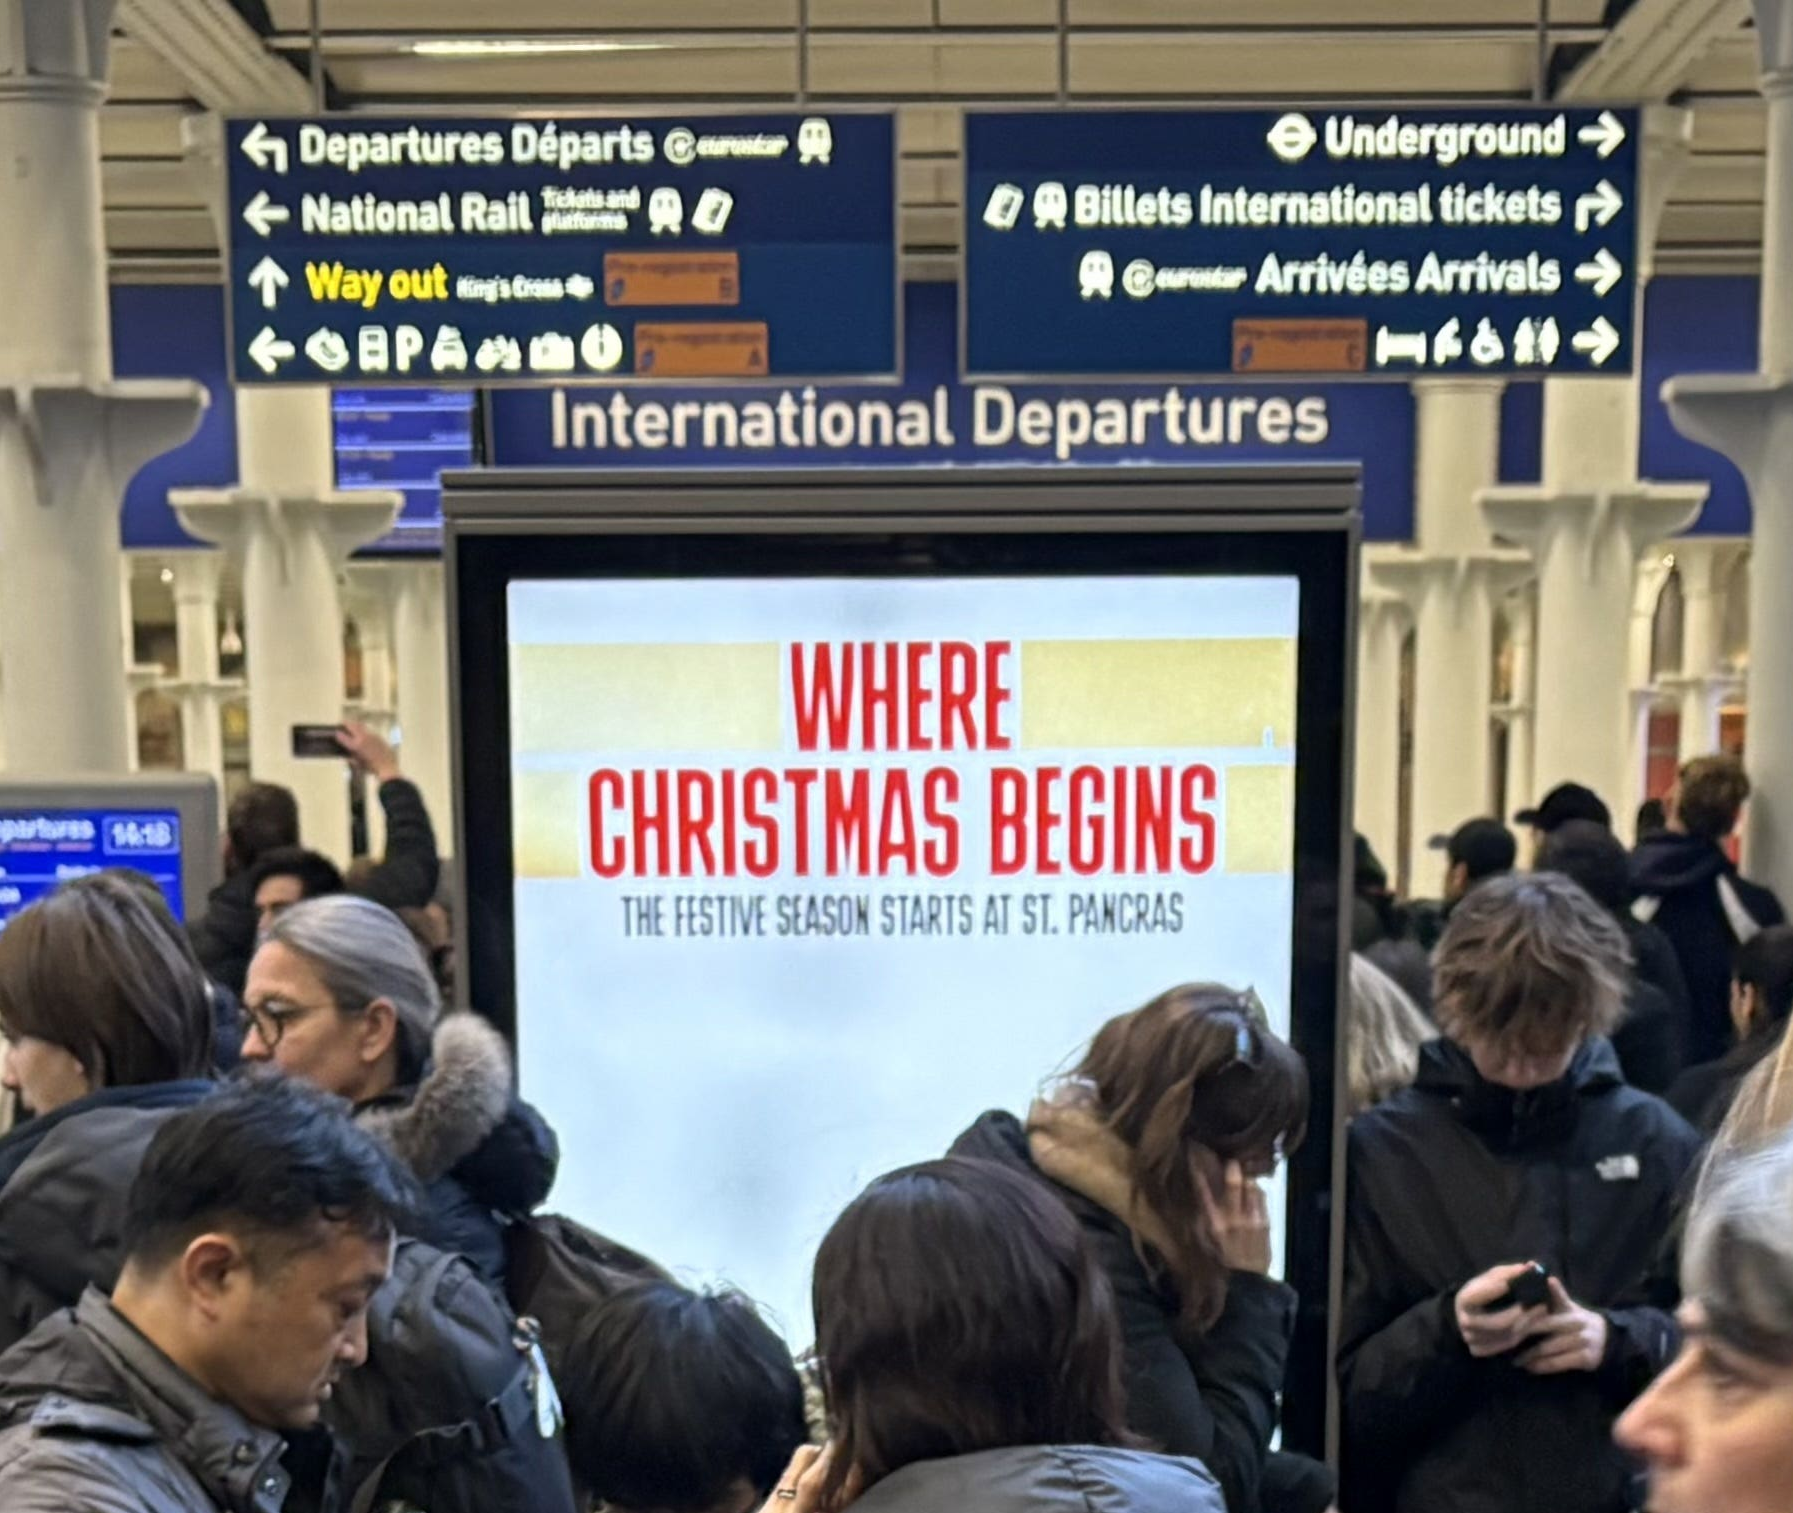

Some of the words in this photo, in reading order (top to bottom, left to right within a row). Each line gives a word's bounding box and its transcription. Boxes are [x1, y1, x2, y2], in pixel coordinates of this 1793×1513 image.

[300, 126, 504, 171] Departures
[511, 121, 654, 171] Départs
[1326, 115, 1565, 165] Underground
[302, 193, 454, 232] National
[461, 192, 533, 231] Rail
[1075, 185, 1192, 225] Billets
[1200, 184, 1432, 224] International
[1439, 183, 1561, 222] tickets
[306, 262, 383, 308] Way
[389, 263, 448, 299] out
[1255, 251, 1409, 294] Arrivées
[1415, 252, 1560, 292] Arrivals
[552, 389, 954, 447] International
[974, 388, 1328, 459] Departures
[792, 642, 1010, 751] WHERE
[590, 768, 959, 878] CHRISTMAS
[991, 765, 1216, 875] BEGINS
[621, 896, 663, 936] THE
[675, 895, 765, 936] FESTIVE
[777, 895, 869, 936] SEASON
[881, 894, 972, 936] STARTS
[984, 894, 1011, 934] AT
[1023, 894, 1058, 934] ST.
[1069, 892, 1183, 933] PANCRAS
